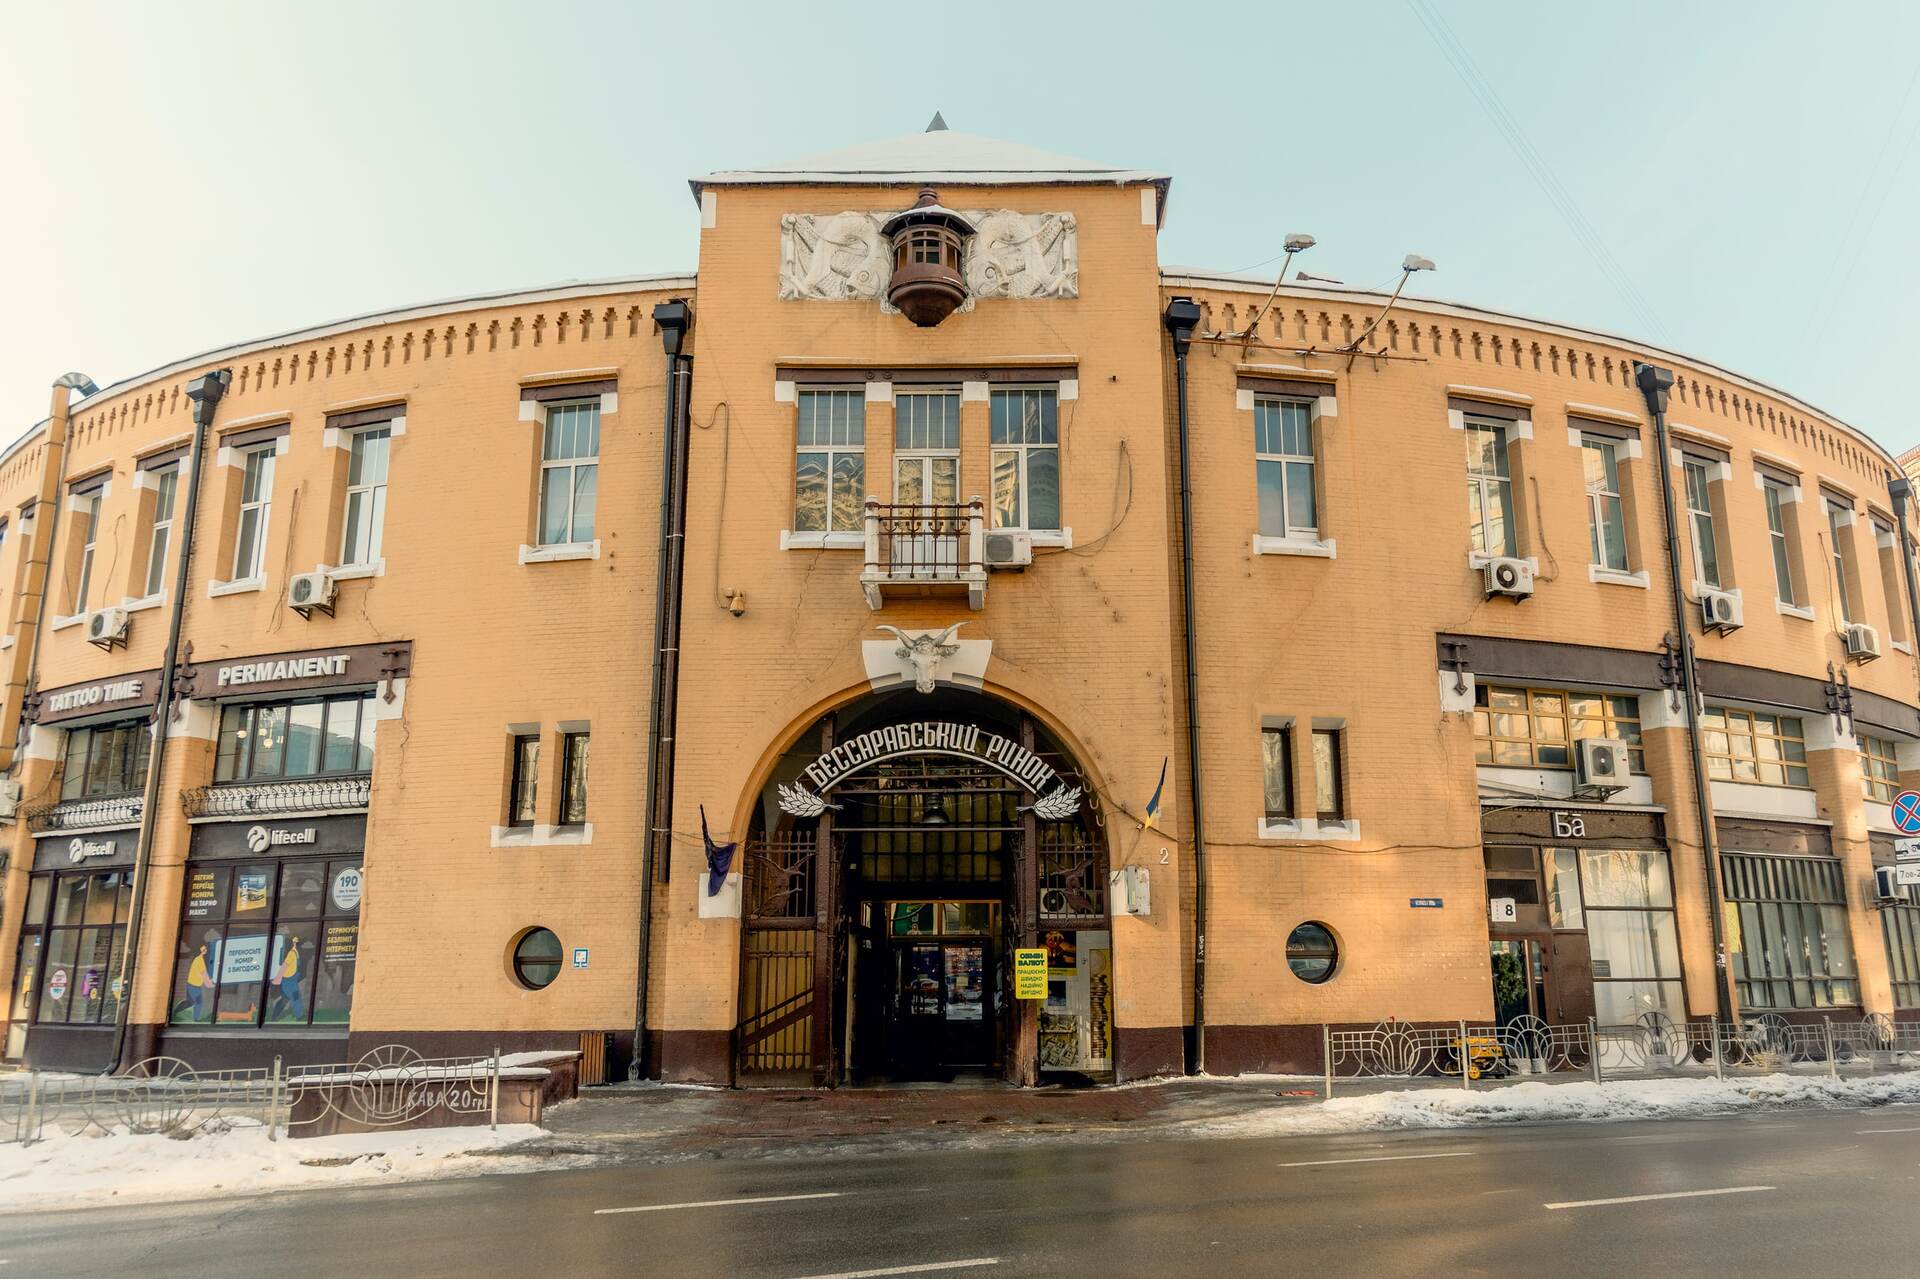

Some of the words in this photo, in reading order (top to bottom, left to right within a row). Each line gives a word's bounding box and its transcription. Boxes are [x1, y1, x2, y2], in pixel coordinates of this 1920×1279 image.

[217, 655, 350, 686] PERMANENT
[50, 686, 102, 712] TATTOO
[103, 680, 142, 702] TIME
[805, 722, 980, 788] БЕССАРАБСЬКИЙ
[985, 735, 1056, 790] РИНОК
[271, 828, 316, 845] lifecell
[84, 840, 116, 857] lifecell
[1160, 847, 1169, 865] 2
[340, 875, 358, 888] 190
[1505, 904, 1514, 917] 8
[407, 1091, 445, 1107] КАВА
